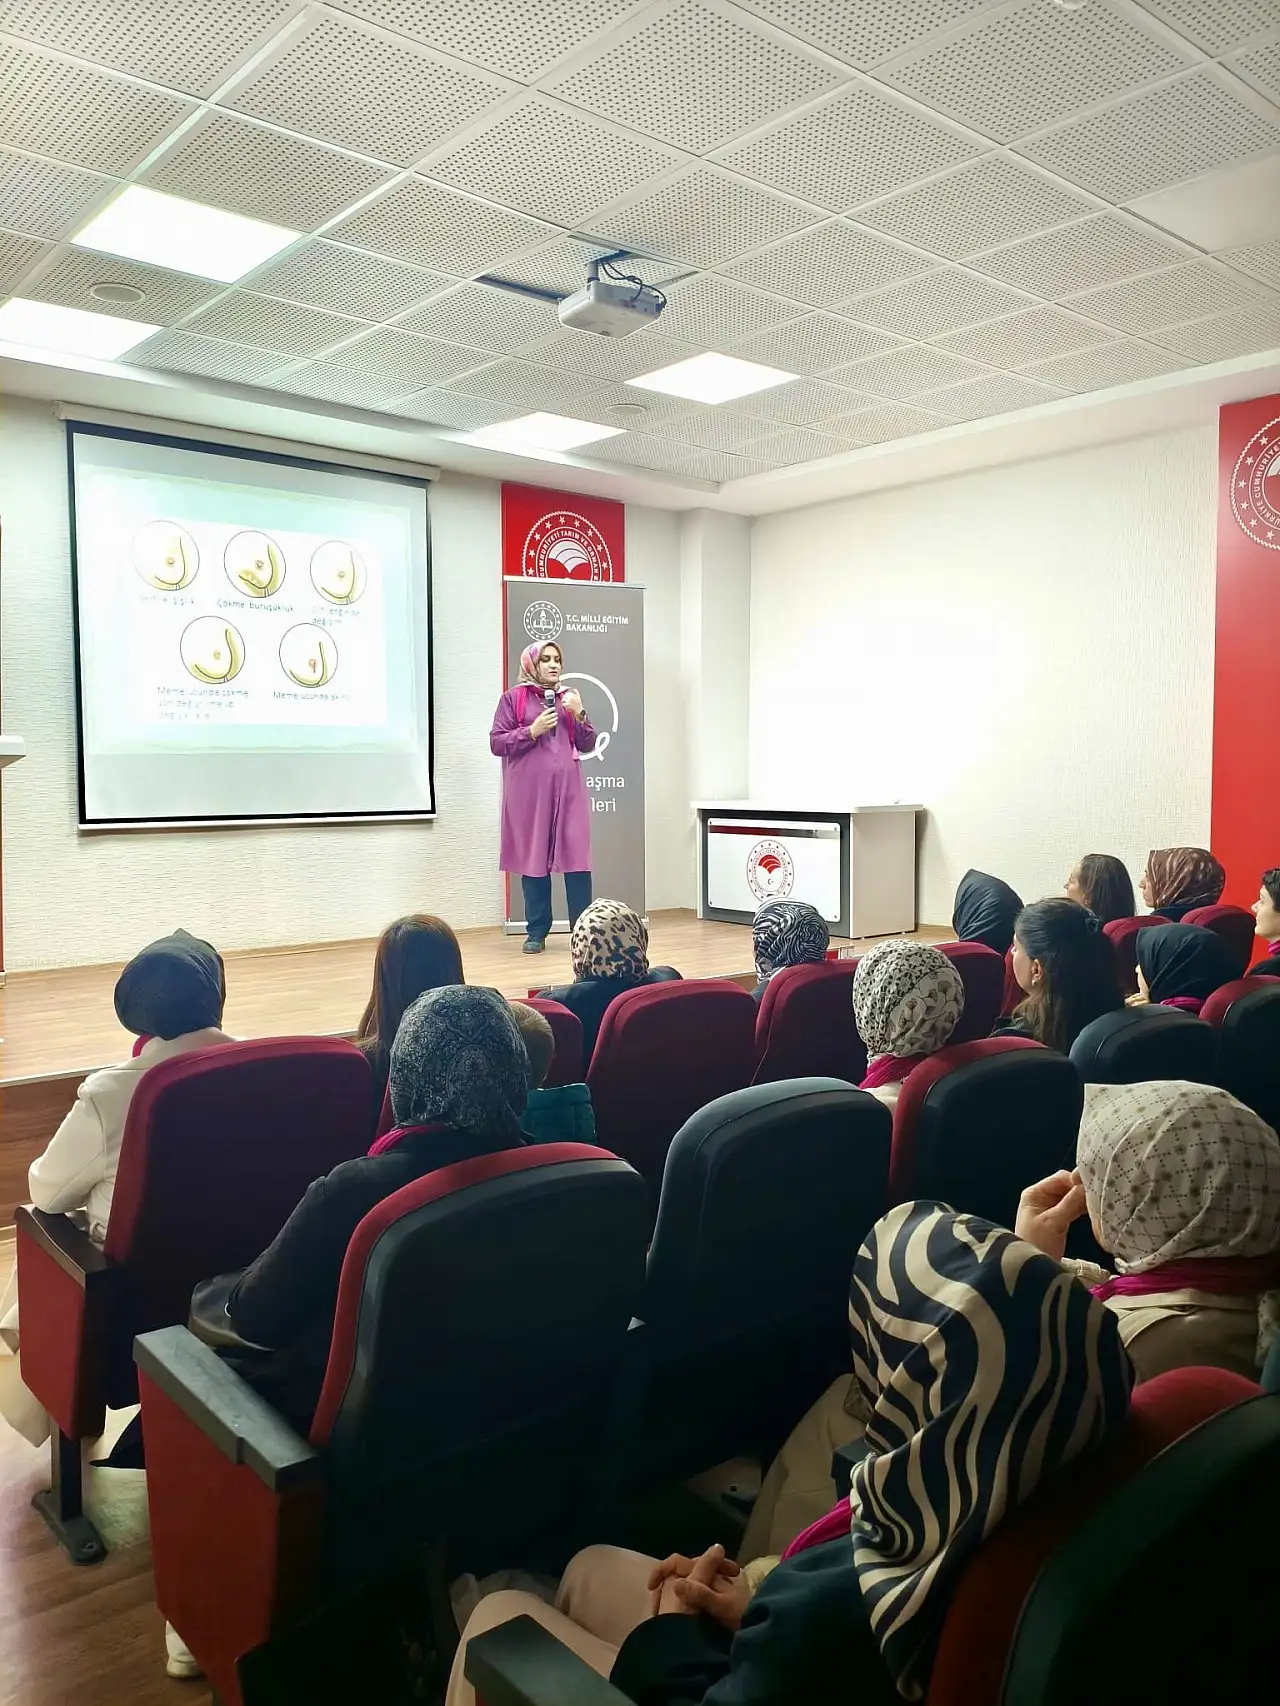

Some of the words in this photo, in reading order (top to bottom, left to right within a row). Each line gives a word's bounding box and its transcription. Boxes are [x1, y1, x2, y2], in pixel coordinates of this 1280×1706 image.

[1254, 441, 1280, 498] CUMHURİYE
[560, 530, 580, 540] TARIM
[580, 537, 588, 547] VE
[587, 546, 599, 574] ORMAN
[566, 614, 580, 622] T.C.
[580, 613, 601, 624] MİLLİ
[602, 615, 629, 625] EĞİTİM
[566, 623, 608, 633] BAKANLIĞI
[586, 775, 625, 792] aşma
[591, 797, 616, 812] leri
